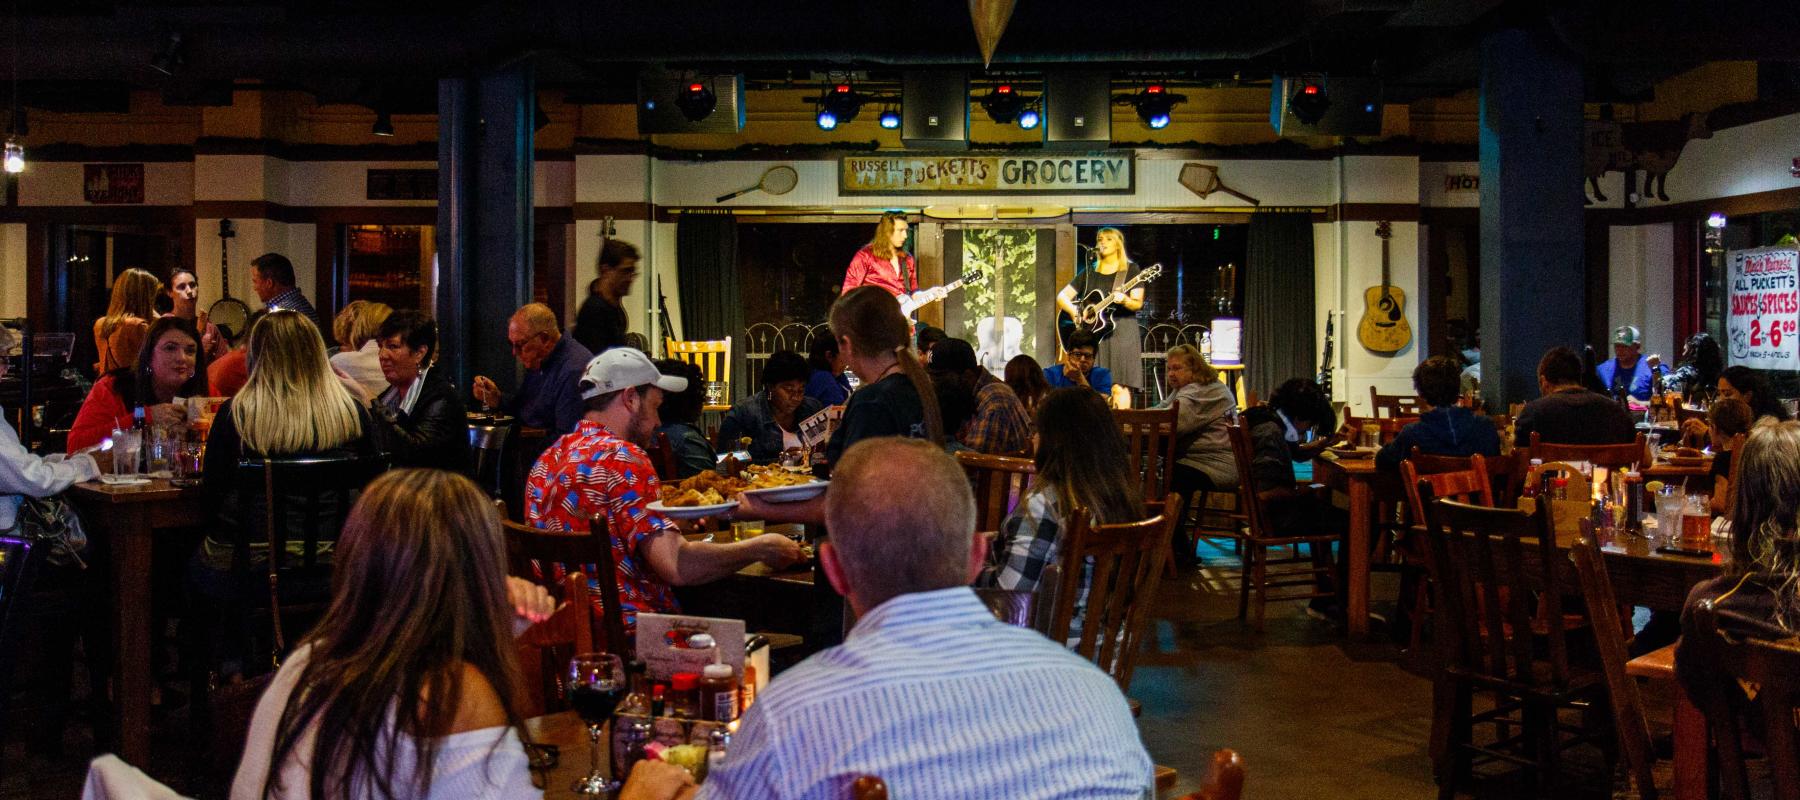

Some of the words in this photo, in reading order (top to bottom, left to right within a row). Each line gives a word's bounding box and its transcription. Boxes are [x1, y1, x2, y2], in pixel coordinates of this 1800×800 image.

[851, 159, 903, 173] RUSSELL
[903, 157, 990, 187] PUCKETT'S
[1002, 159, 1123, 185] GROCERY
[1735, 279, 1749, 291] ALL
[1762, 289, 1799, 315] SPICES
[1750, 319, 1761, 347] 2
